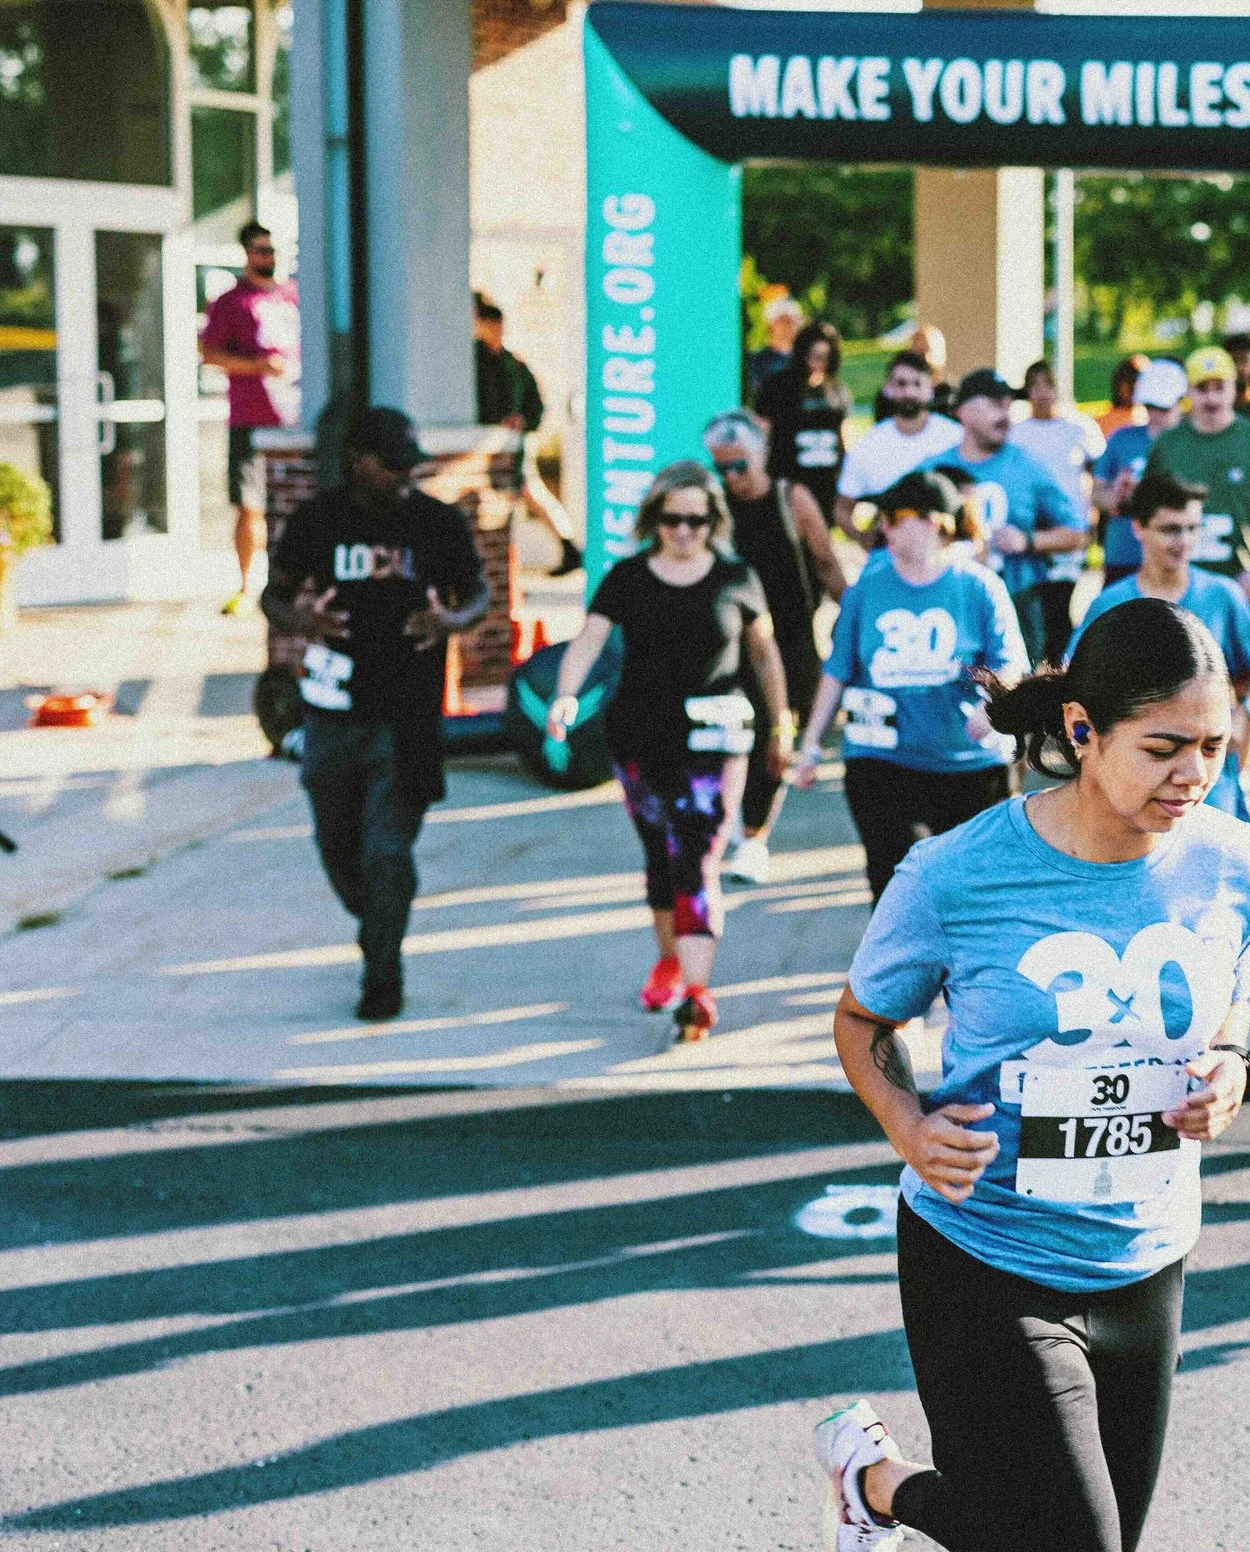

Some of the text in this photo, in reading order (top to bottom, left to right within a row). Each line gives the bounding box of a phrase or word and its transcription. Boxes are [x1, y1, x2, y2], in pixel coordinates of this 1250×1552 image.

[729, 54, 892, 121] MAKE
[903, 58, 1067, 125] YOUR
[602, 192, 656, 568] ENTURE.ORG
[1059, 1114, 1152, 1158] 1785
